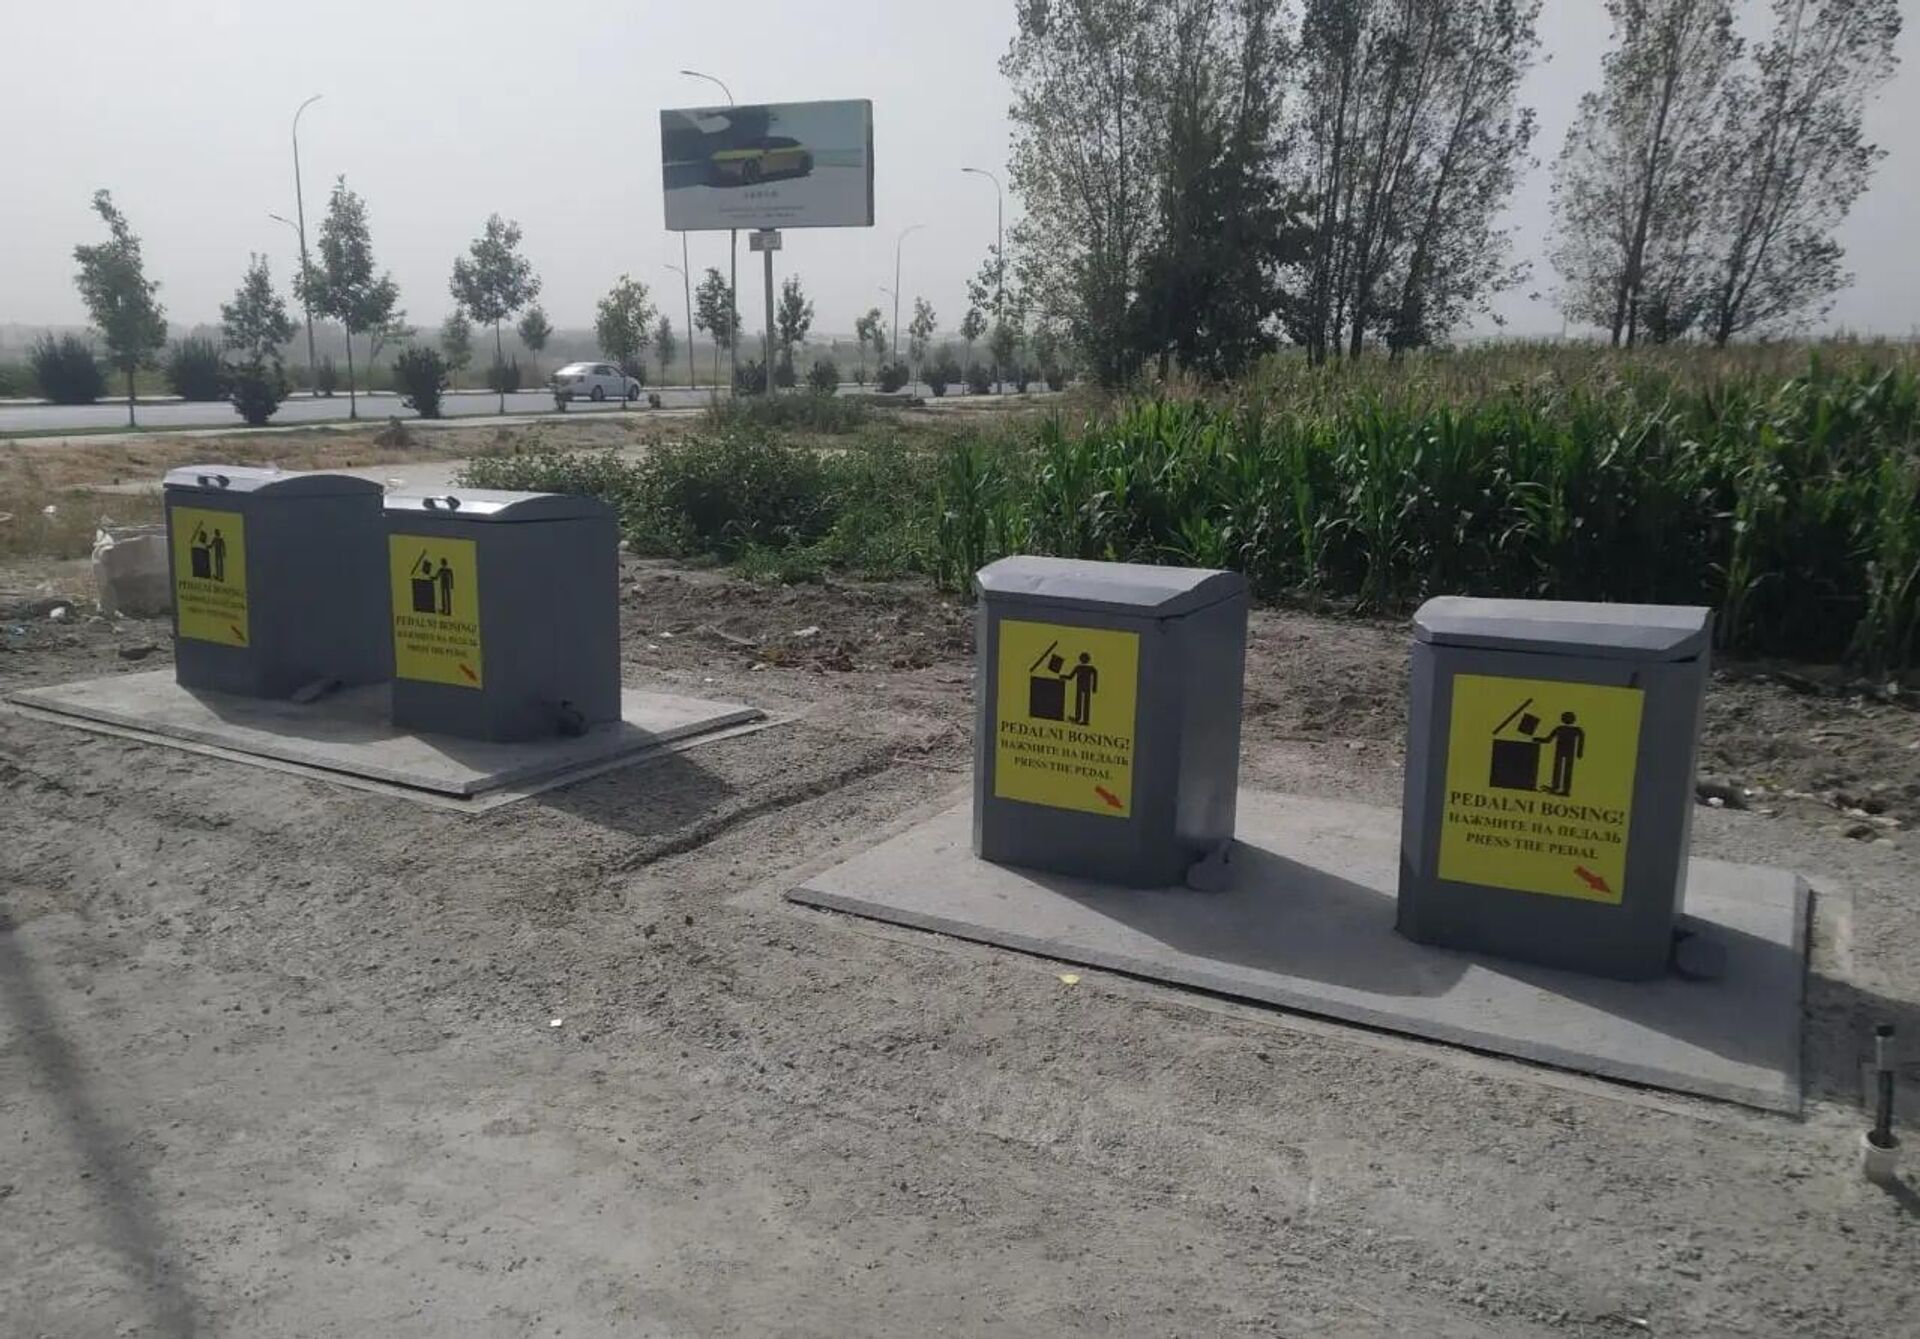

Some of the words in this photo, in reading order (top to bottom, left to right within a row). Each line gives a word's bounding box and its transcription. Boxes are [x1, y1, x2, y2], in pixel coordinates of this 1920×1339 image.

[1001, 720, 1063, 741] PEDALNI
[1067, 730, 1130, 750] BOSING!
[1000, 739, 1057, 756] НАЖМИТЕ
[1061, 748, 1077, 759] НА
[1080, 750, 1129, 766] ПЕДАЛЬ
[1014, 757, 1048, 770] PRESS
[1049, 762, 1073, 773] THE
[1075, 766, 1113, 780] PEDAL
[1450, 791, 1535, 814] PEDALNI
[1541, 802, 1625, 825] BOSING!
[1449, 811, 1527, 833] НАЖМИТЕ
[1532, 824, 1553, 835] НА
[1557, 826, 1622, 844] ПЕДАЛЬ
[1466, 832, 1511, 848] PRESS
[1513, 839, 1546, 852] THE
[1549, 843, 1599, 860] PEDAL
